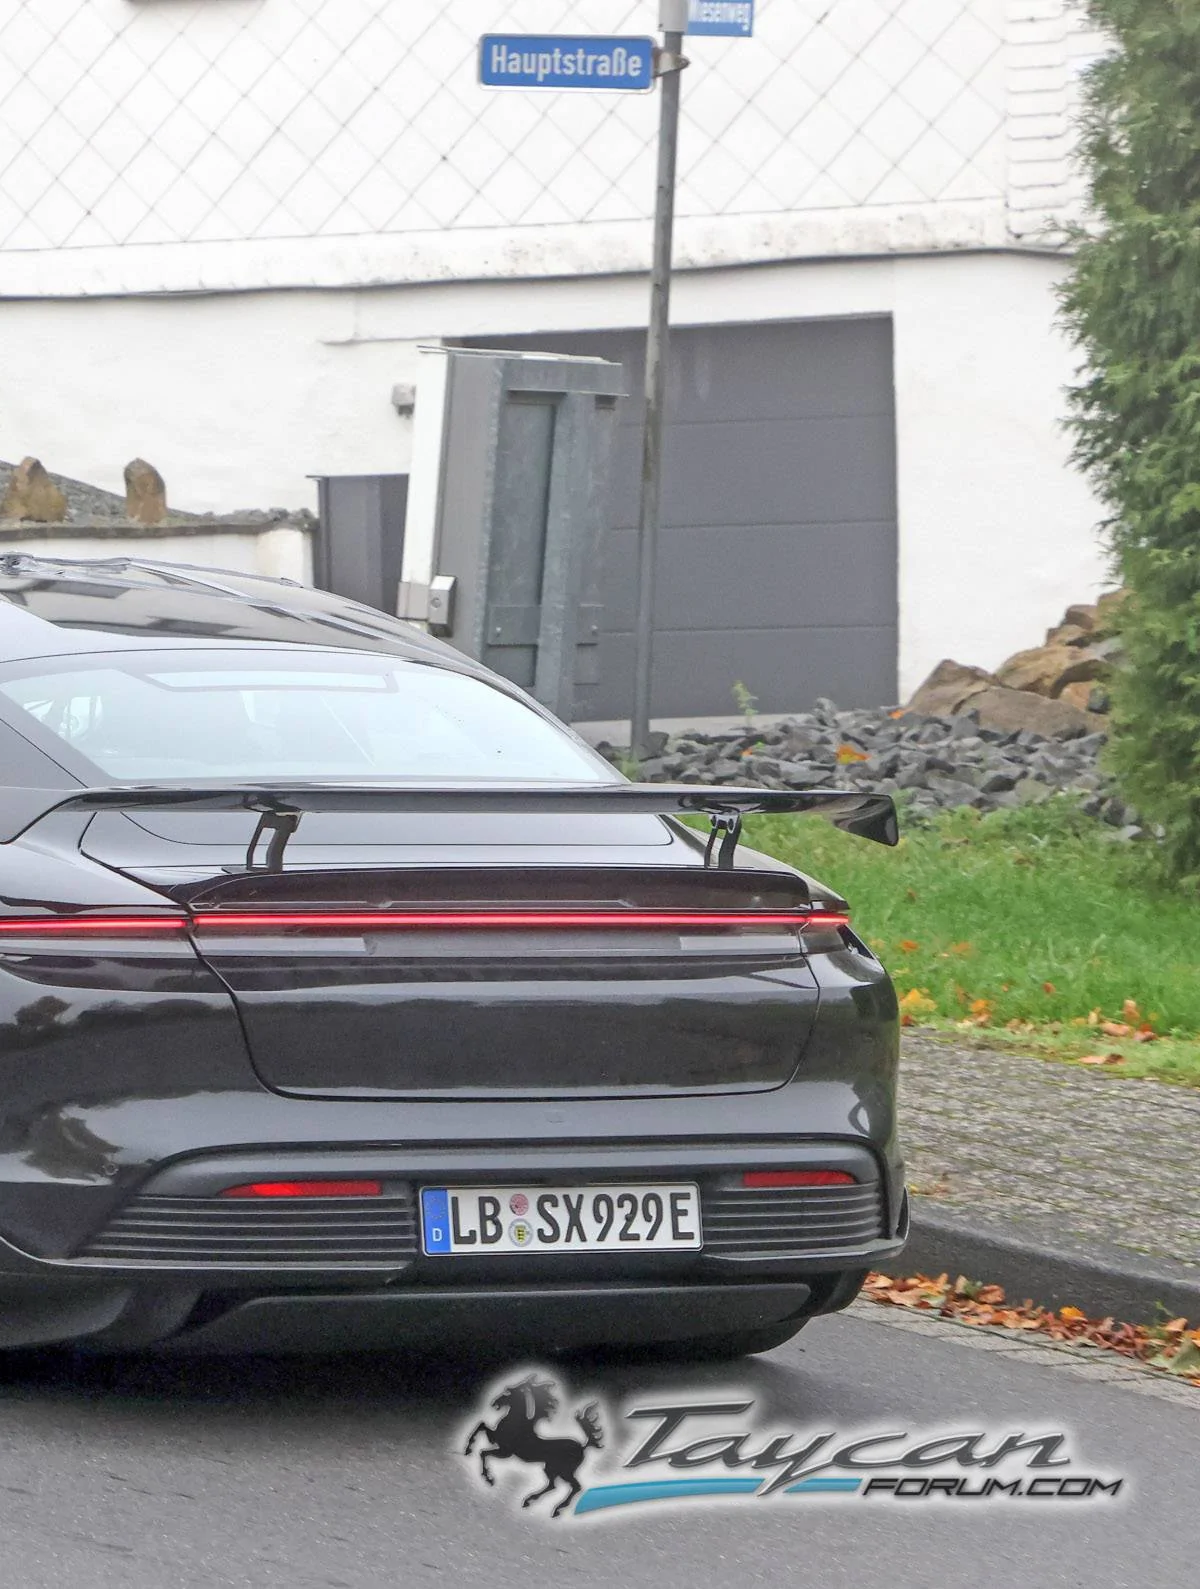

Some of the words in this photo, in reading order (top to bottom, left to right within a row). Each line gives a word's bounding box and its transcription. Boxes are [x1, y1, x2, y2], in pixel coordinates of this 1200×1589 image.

[491, 45, 642, 82] Hauptstraße
[432, 1228, 442, 1242] D
[451, 1196, 503, 1245] LB
